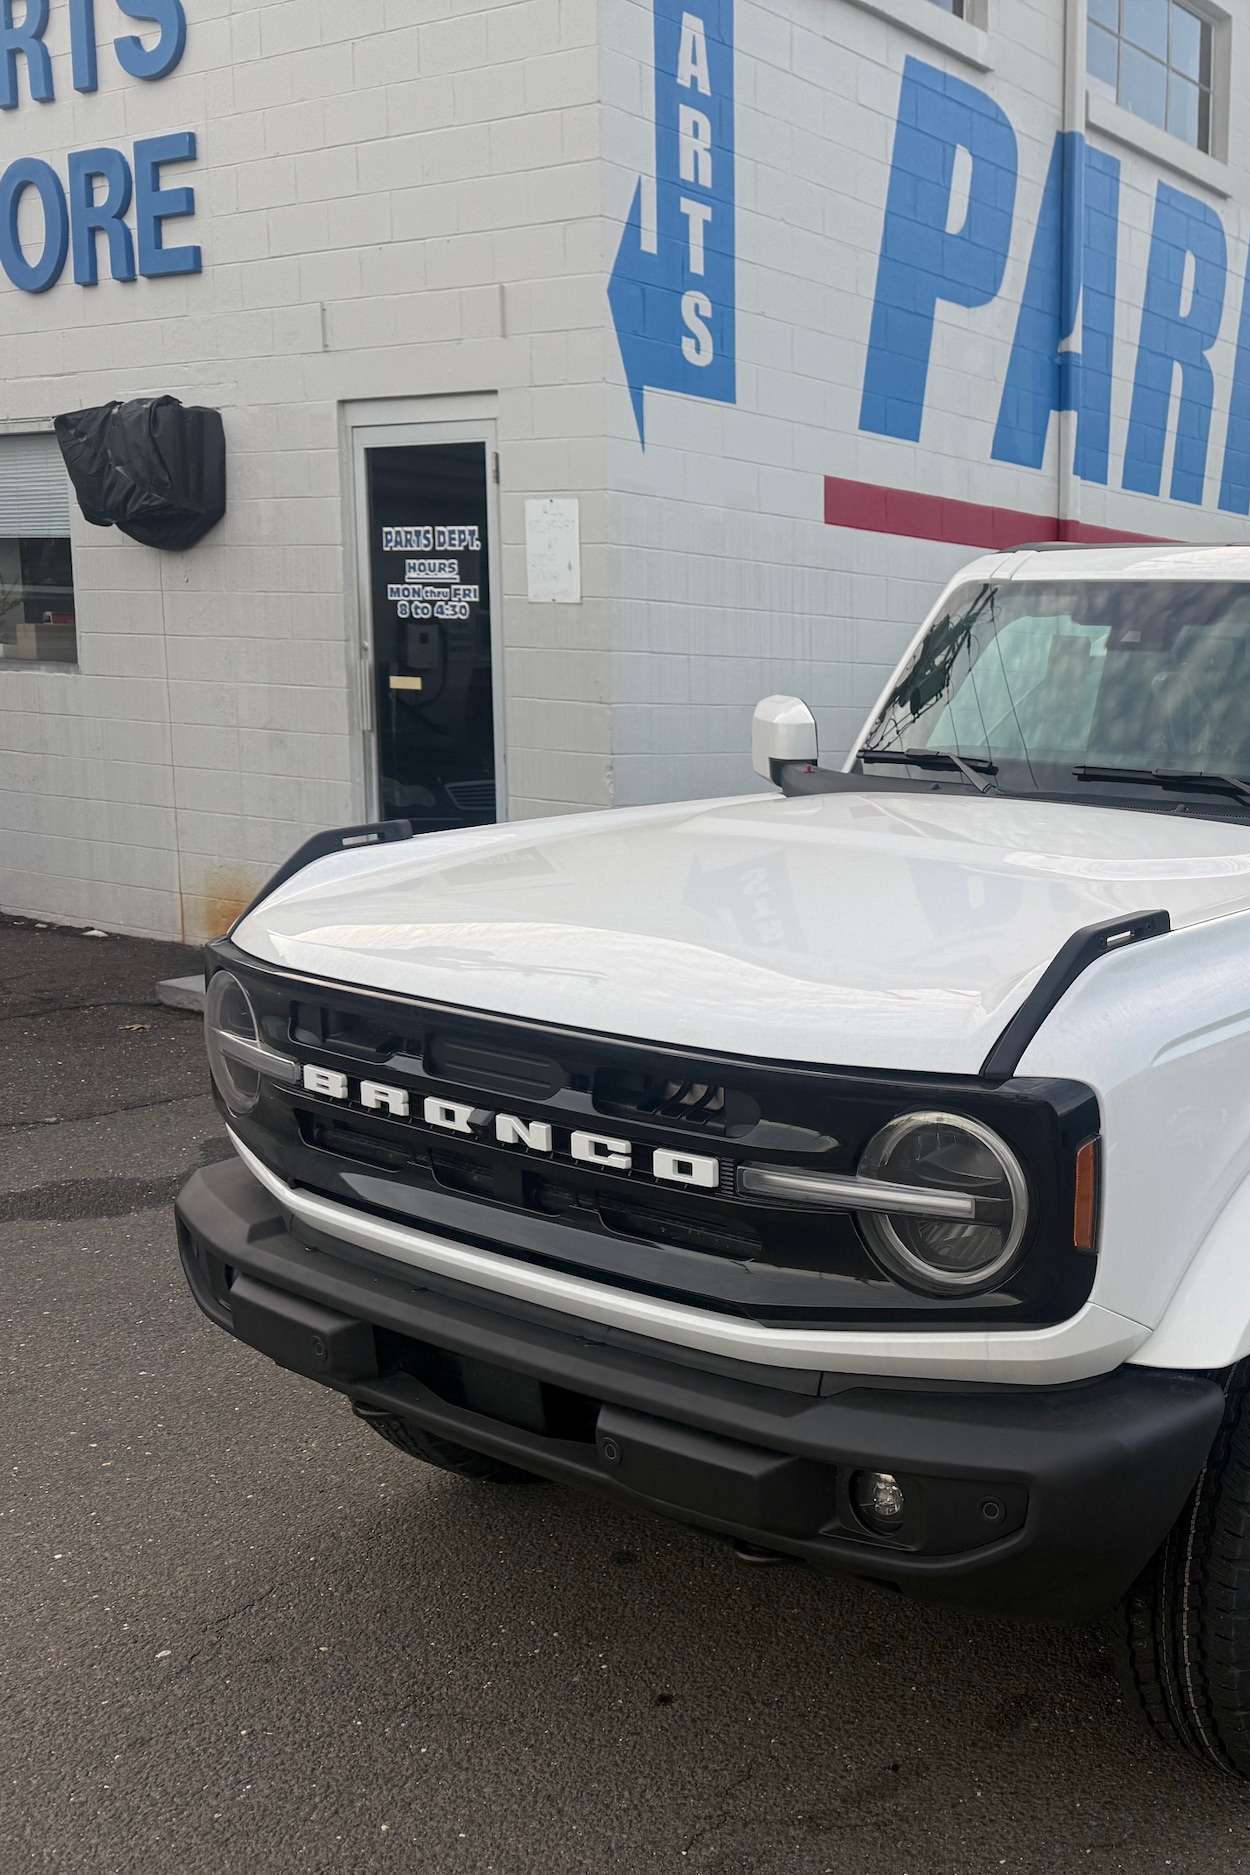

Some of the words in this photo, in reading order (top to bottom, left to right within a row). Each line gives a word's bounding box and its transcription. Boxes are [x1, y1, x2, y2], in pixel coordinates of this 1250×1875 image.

[382, 526, 432, 551] PARTS
[434, 526, 481, 551] DEPT.
[405, 559, 458, 575] HOURS
[387, 584, 422, 600] MON
[423, 586, 450, 600] thru
[450, 585, 479, 602] FRI
[397, 601, 409, 618] 8
[411, 601, 432, 618] to
[434, 602, 469, 619] 4:30
[303, 1063, 720, 1188] BRONCO
